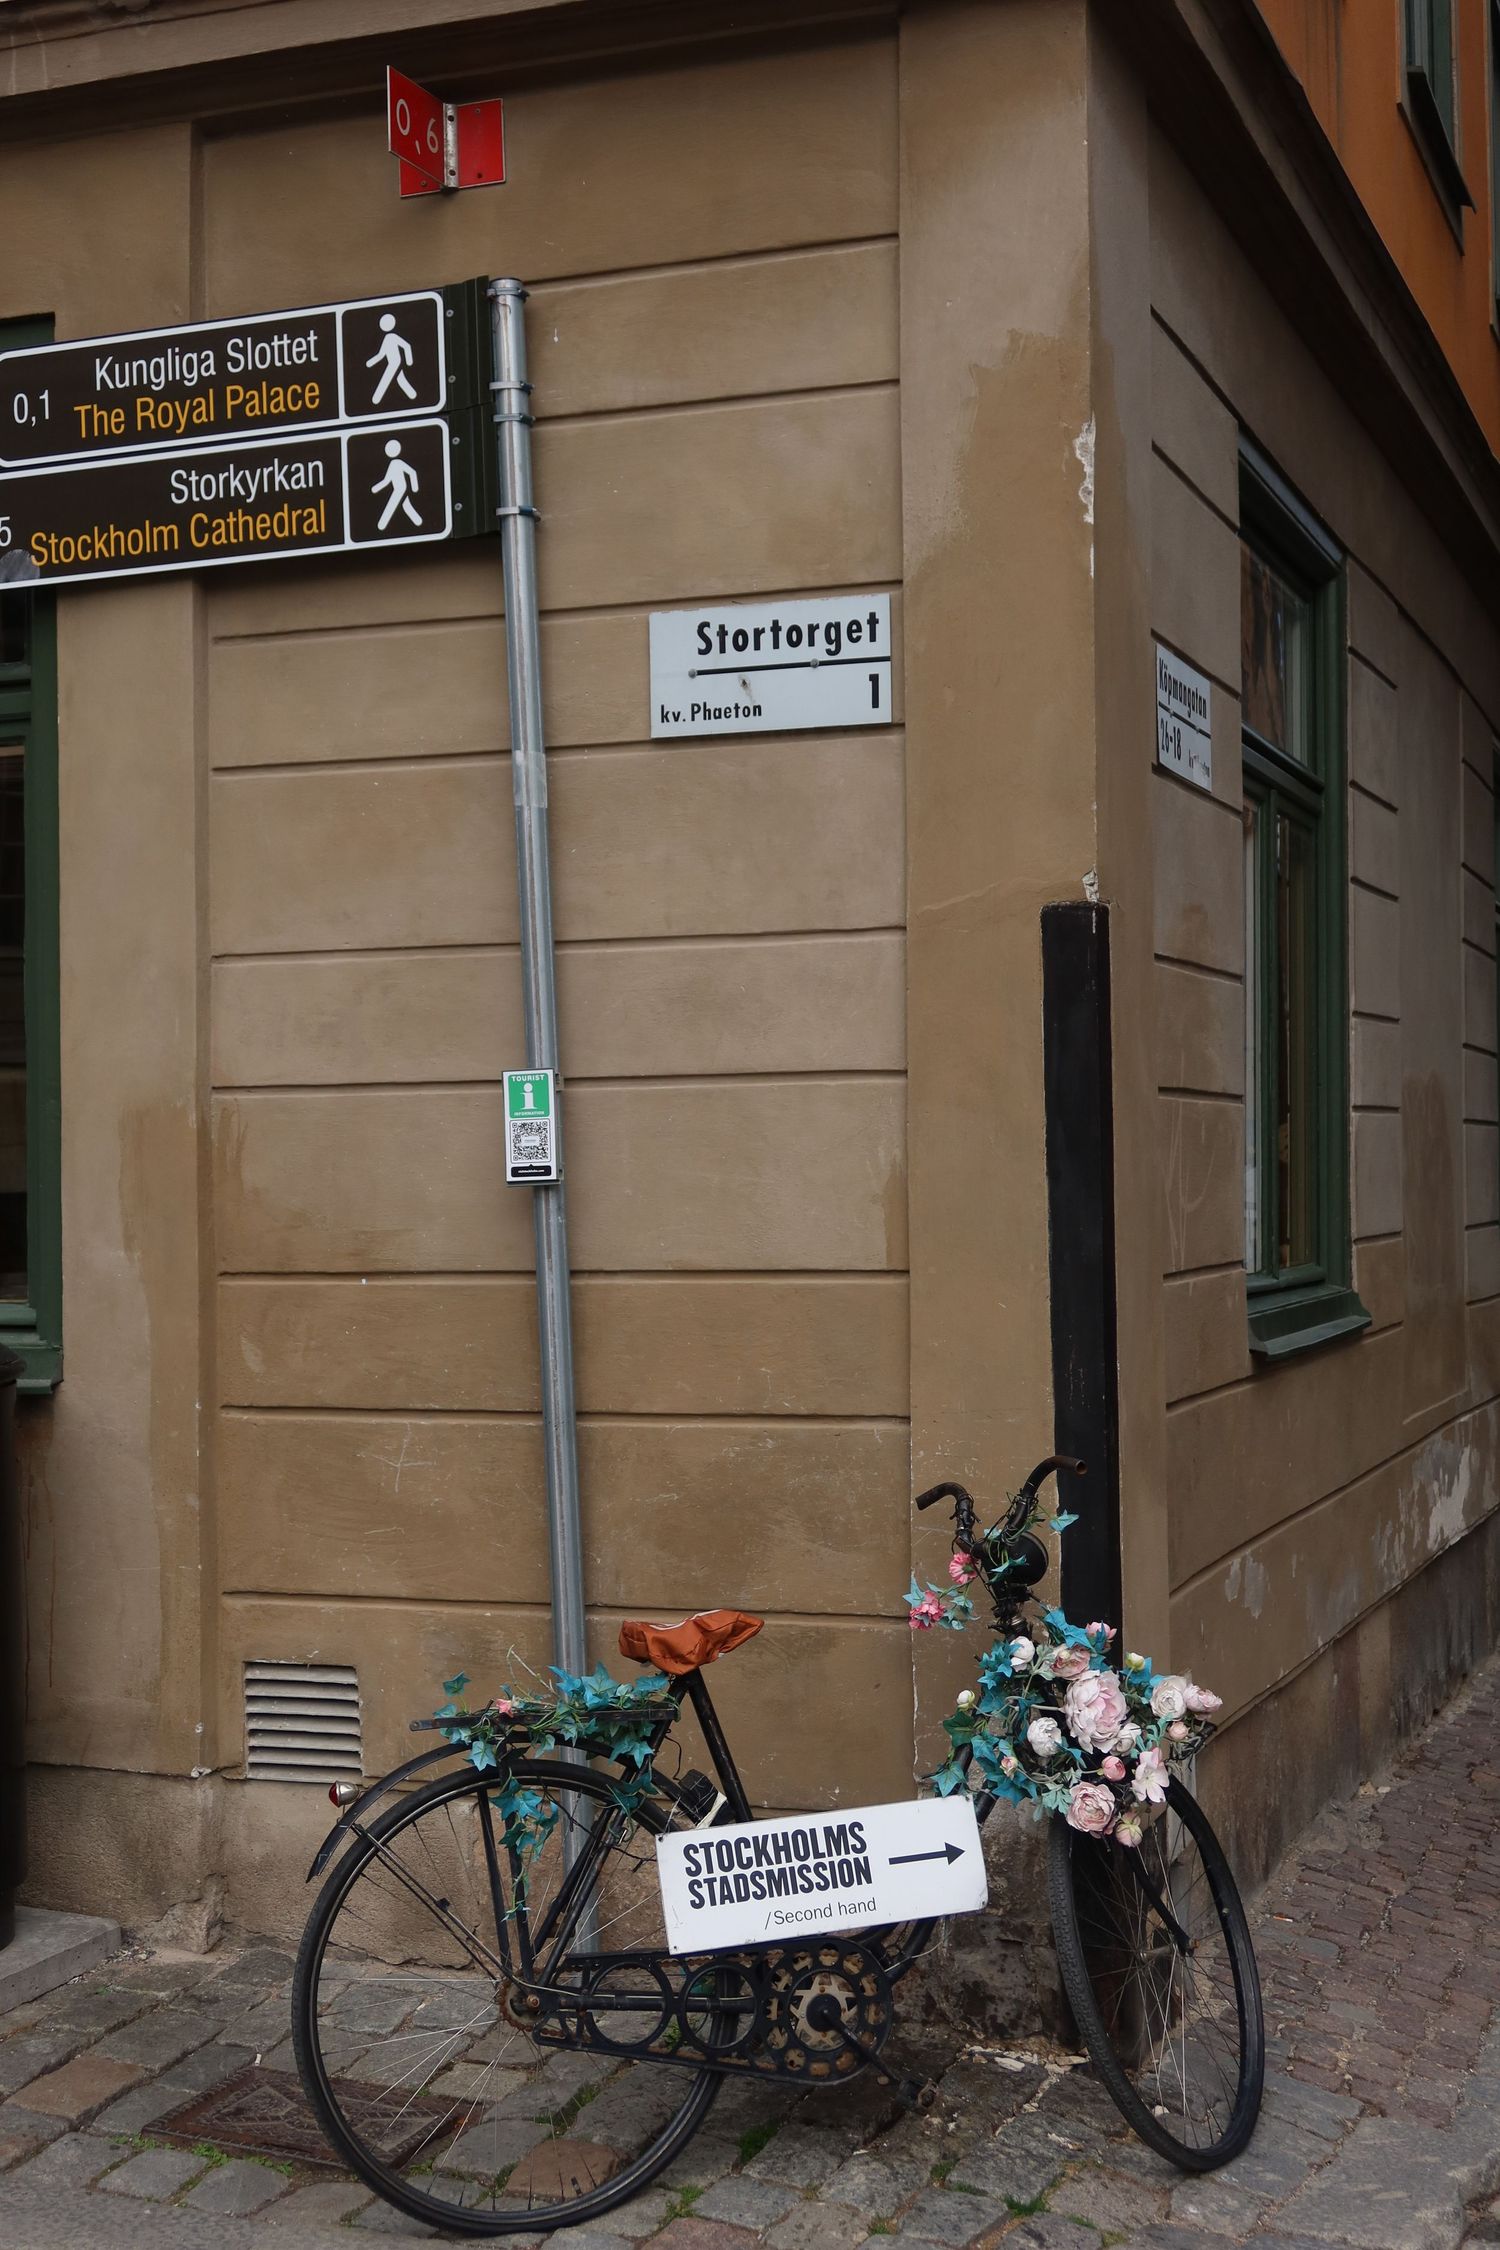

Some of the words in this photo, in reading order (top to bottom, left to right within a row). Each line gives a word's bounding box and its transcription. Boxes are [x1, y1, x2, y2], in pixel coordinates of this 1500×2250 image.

[396, 98, 439, 156] 0,6
[94, 347, 217, 391] Kungliga
[226, 330, 319, 373] Slottet
[13, 389, 51, 428] 0,1
[73, 402, 126, 439] The
[136, 389, 216, 434] Royal
[226, 381, 321, 419] Palace
[170, 458, 325, 505] Storkyrkan
[30, 519, 179, 566] Stockholm
[189, 499, 327, 549] Cathedral
[696, 611, 880, 657] Stortorget
[660, 703, 687, 724] kv.
[690, 701, 763, 722] Phaeton
[868, 673, 880, 709] 1
[1159, 658, 1207, 719] Köpmangatan
[682, 1821, 867, 1878] STOCKHOLMS
[687, 1855, 873, 1910] STADSMISSION
[765, 1903, 833, 1930] /Second
[838, 1897, 877, 1916] hand
